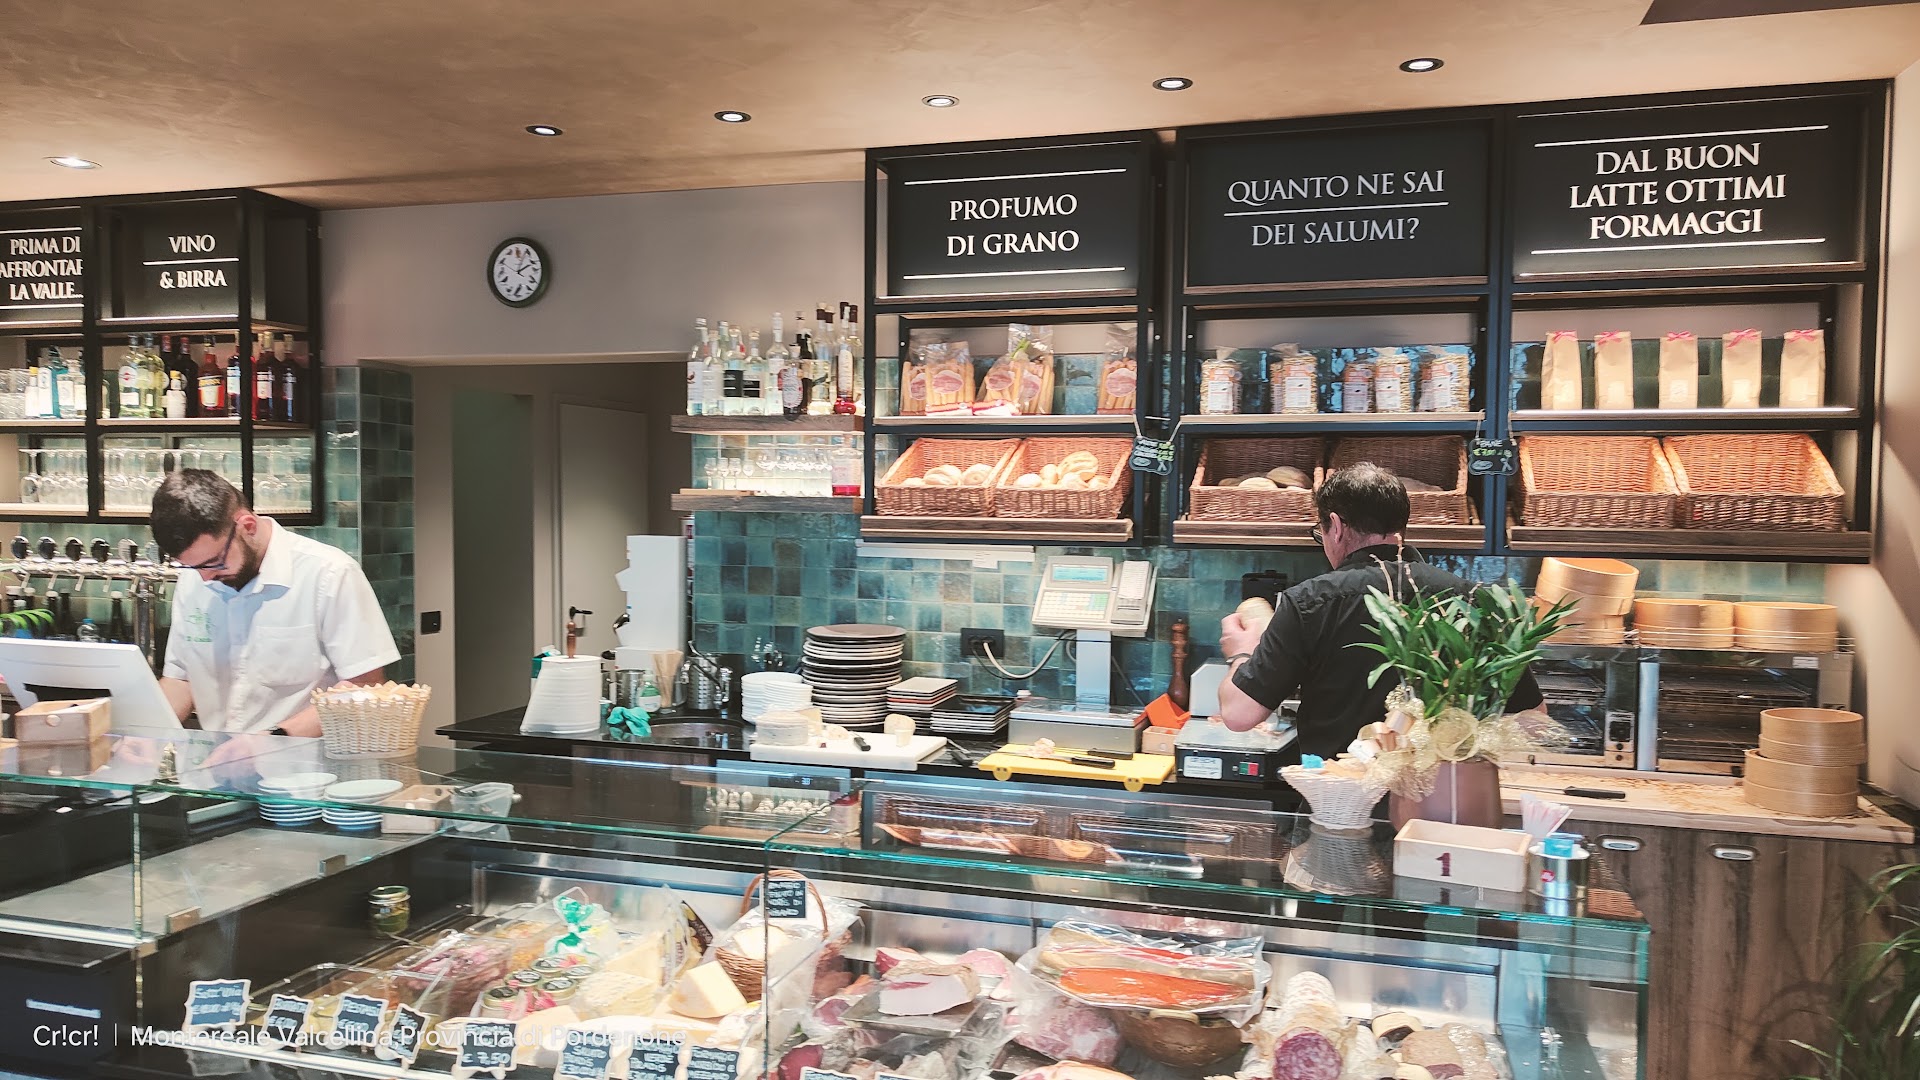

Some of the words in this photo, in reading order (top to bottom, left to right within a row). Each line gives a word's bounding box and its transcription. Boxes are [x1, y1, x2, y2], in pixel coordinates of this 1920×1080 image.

[1596, 149, 1658, 175] DAL
[1665, 142, 1761, 171] BUON
[1228, 175, 1349, 206] QUANTO
[1356, 172, 1395, 196] NE
[1402, 169, 1445, 194] SAI
[1569, 181, 1658, 208] LATTE
[1665, 174, 1787, 204] OTTIMI
[949, 193, 1078, 221] PROFUMO
[1252, 223, 1296, 246] DEI
[1303, 217, 1420, 244] SALUMI?
[1589, 208, 1763, 240] FORMAGGI
[10, 237, 60, 255] PRIMA
[62, 235, 81, 253] DI
[168, 234, 216, 253] VINO
[946, 235, 975, 257] DI
[982, 230, 1080, 255] GRANO
[9, 283, 31, 300] LA
[160, 271, 176, 289] &
[176, 269, 228, 288] BIRRA
[1436, 852, 1452, 877] 1
